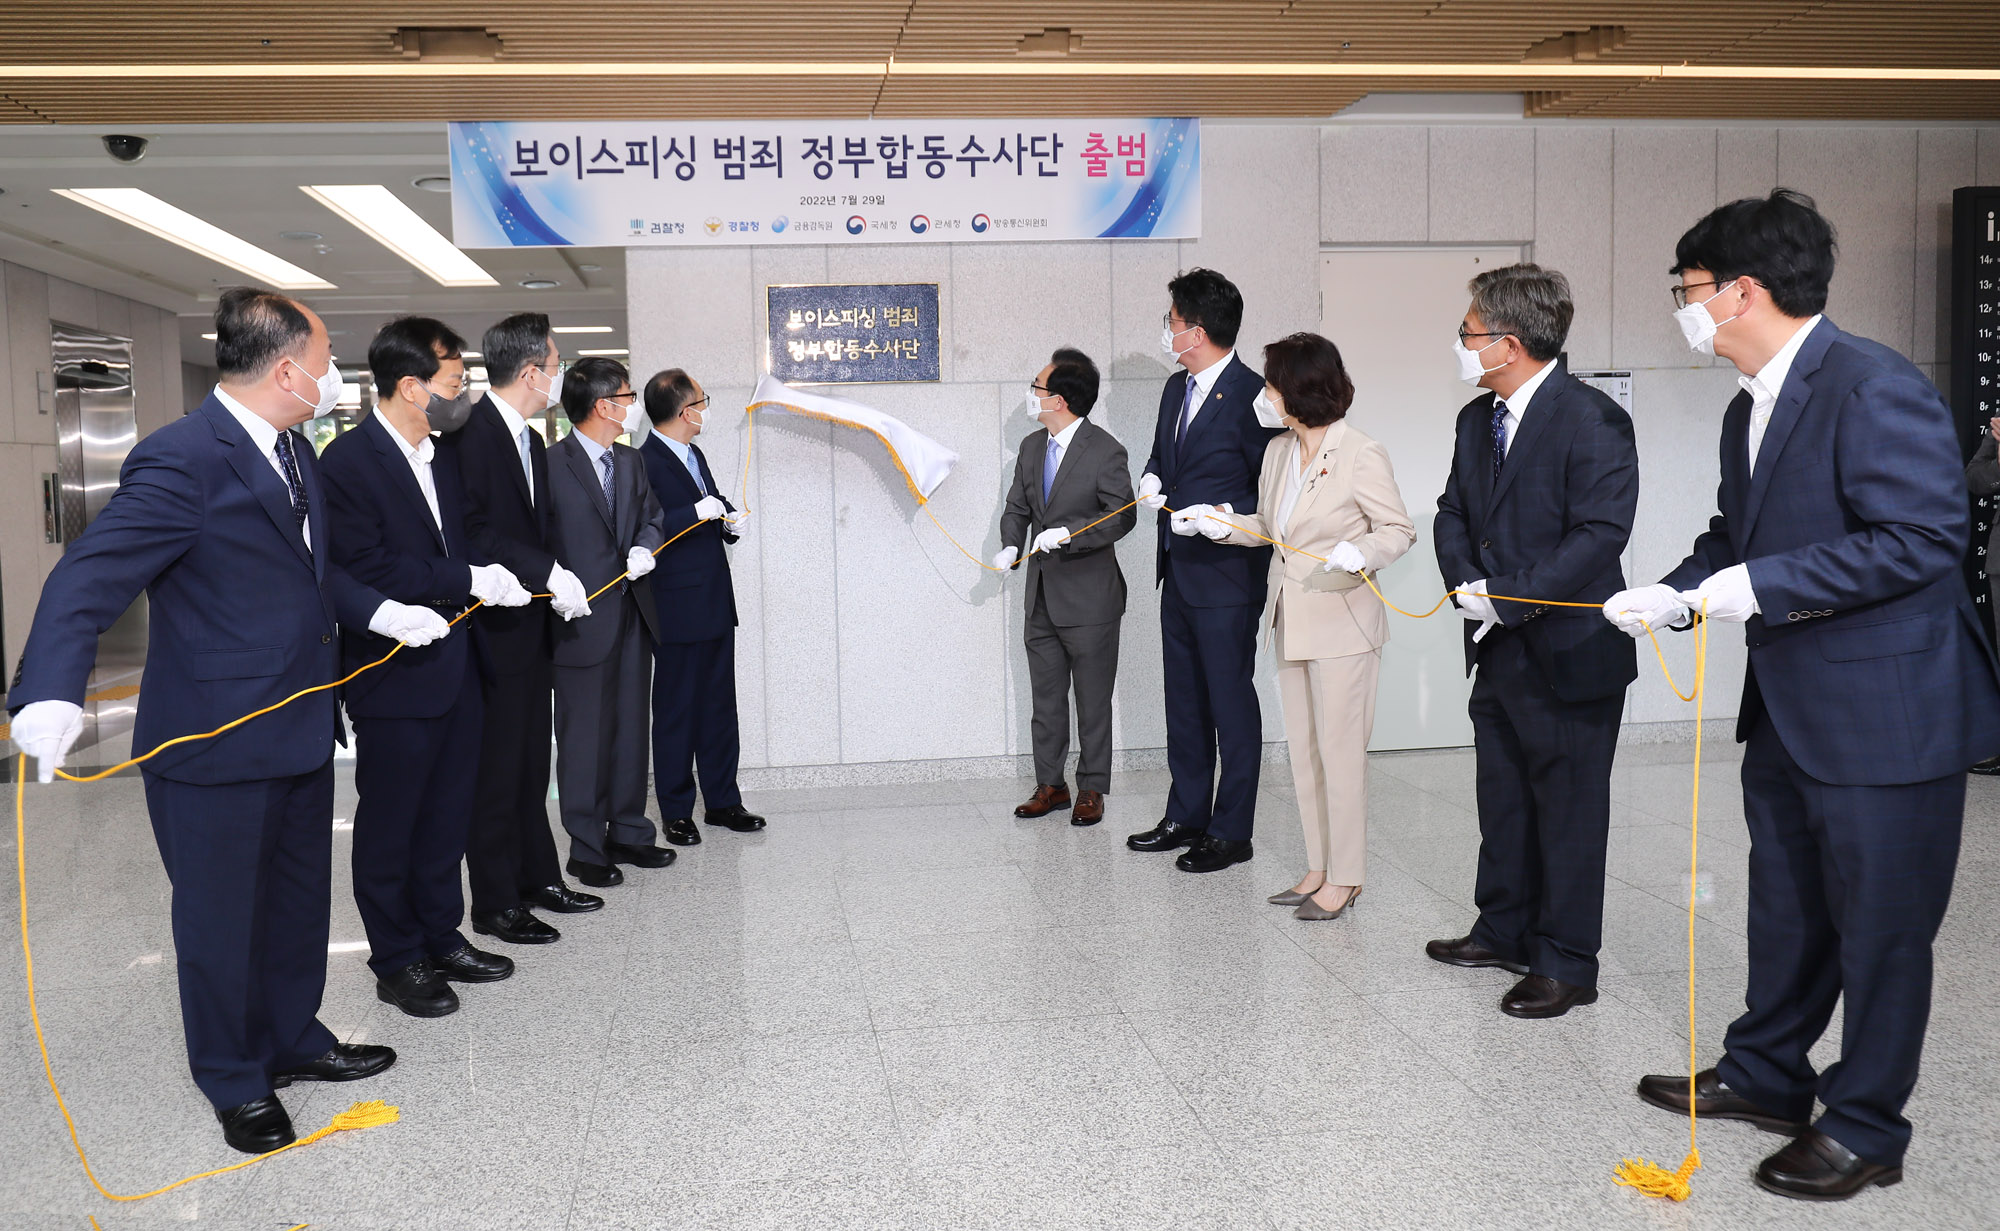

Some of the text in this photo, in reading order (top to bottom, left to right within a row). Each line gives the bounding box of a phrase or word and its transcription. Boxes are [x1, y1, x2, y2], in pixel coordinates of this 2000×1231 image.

[510, 132, 1147, 181] 보이스피싱 범죄 정부합동수사단 출범
[799, 194, 886, 206] 2022년 7월 29일
[650, 222, 685, 234] 검찰청
[728, 220, 760, 233] 경찰청
[794, 221, 833, 232] 금융감독원
[871, 220, 898, 230] 국세청
[934, 219, 961, 229] 관세청
[993, 218, 1048, 228] 방송통신위원회
[1980, 254, 1993, 265] 14F
[1979, 279, 1993, 290] 13F
[1978, 303, 1993, 314] 12F
[786, 306, 918, 329] 보이스피싱 범죄
[1978, 328, 1993, 338] 11F
[787, 339, 921, 362] 정부합동수사단
[1977, 352, 1992, 362] 10F
[1980, 376, 1990, 386] 9F
[1979, 401, 1989, 411] 8F
[1978, 498, 1987, 508] 4F
[1978, 522, 1987, 532] 3F
[1977, 546, 1987, 556] 2F
[1978, 570, 1987, 580] 1F
[1976, 594, 1986, 604] B1
